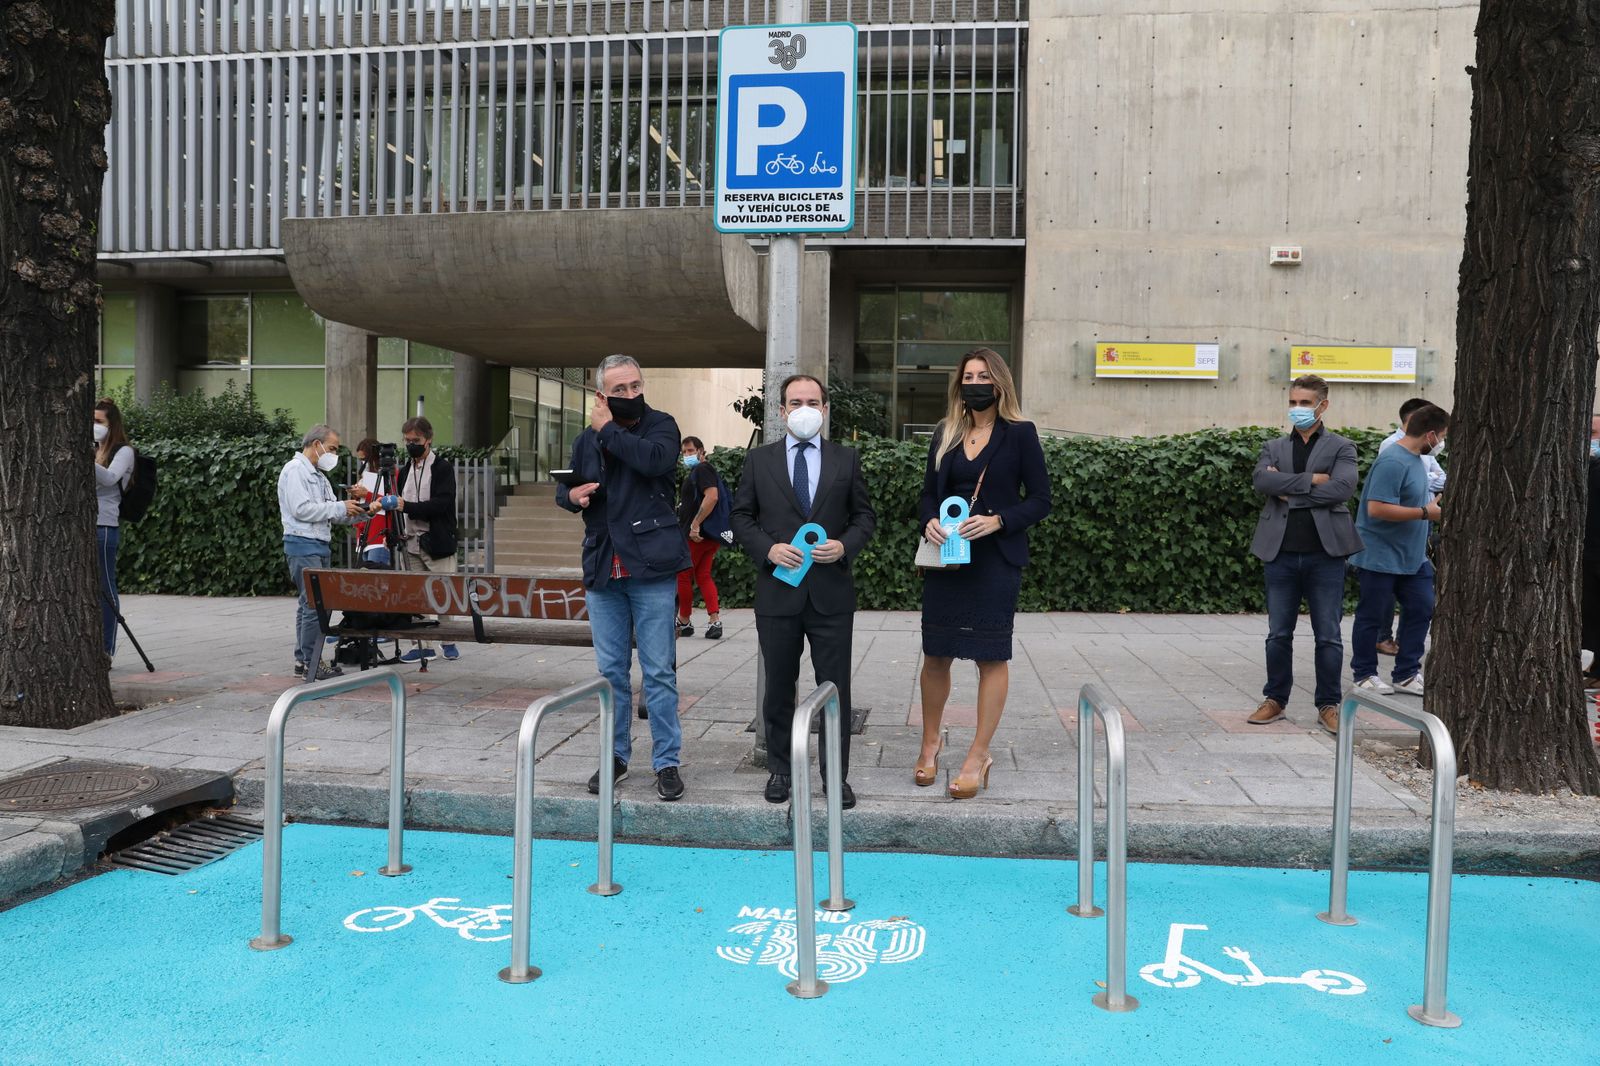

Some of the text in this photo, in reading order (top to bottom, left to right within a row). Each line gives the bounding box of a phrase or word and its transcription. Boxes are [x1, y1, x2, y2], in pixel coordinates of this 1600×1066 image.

[736, 86, 807, 175] P
[724, 192, 844, 202] RESERVA BICICLETAS
[737, 203, 830, 212] Y VEHÍCULOS DE
[721, 213, 846, 223] MOVILIDAD PERSONAL
[1197, 357, 1216, 365] SEPE
